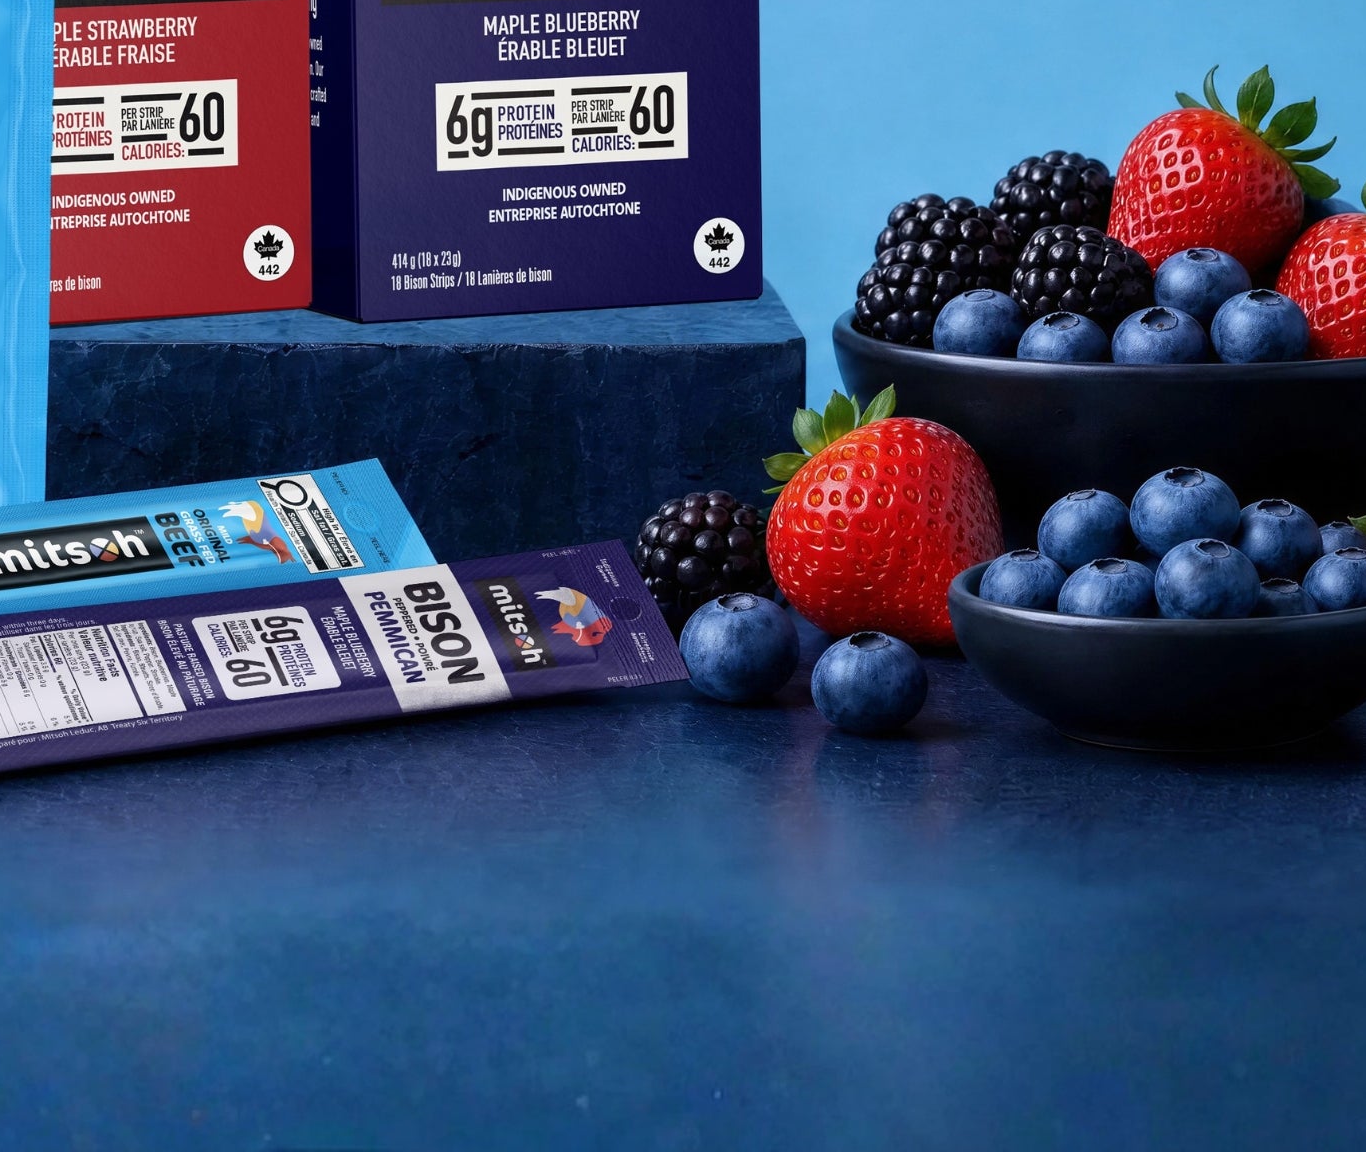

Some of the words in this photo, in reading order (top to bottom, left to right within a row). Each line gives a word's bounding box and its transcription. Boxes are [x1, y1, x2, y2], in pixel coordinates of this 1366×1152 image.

[629, 84, 675, 134] 60
[391, 275, 401, 289] 18
[403, 273, 428, 289] Bison
[430, 271, 455, 290] Strips
[465, 271, 474, 285] 18
[477, 268, 512, 286] Lanières
[515, 268, 526, 283] de
[529, 266, 552, 282] bison
[154, 511, 205, 569] BEEF
[179, 510, 208, 544] GRASS
[196, 543, 216, 564] FED
[192, 507, 231, 563] ORIGINAL
[291, 642, 317, 676] PROTEIN
[334, 605, 356, 632] MAPLE
[348, 632, 378, 678] BLUEBERRY
[364, 589, 426, 684] PEMMICAN
[392, 596, 419, 633] PEPPERED
[417, 642, 439, 670] POIVRÉ
[403, 580, 486, 685] BISON
[226, 658, 272, 686] 60
